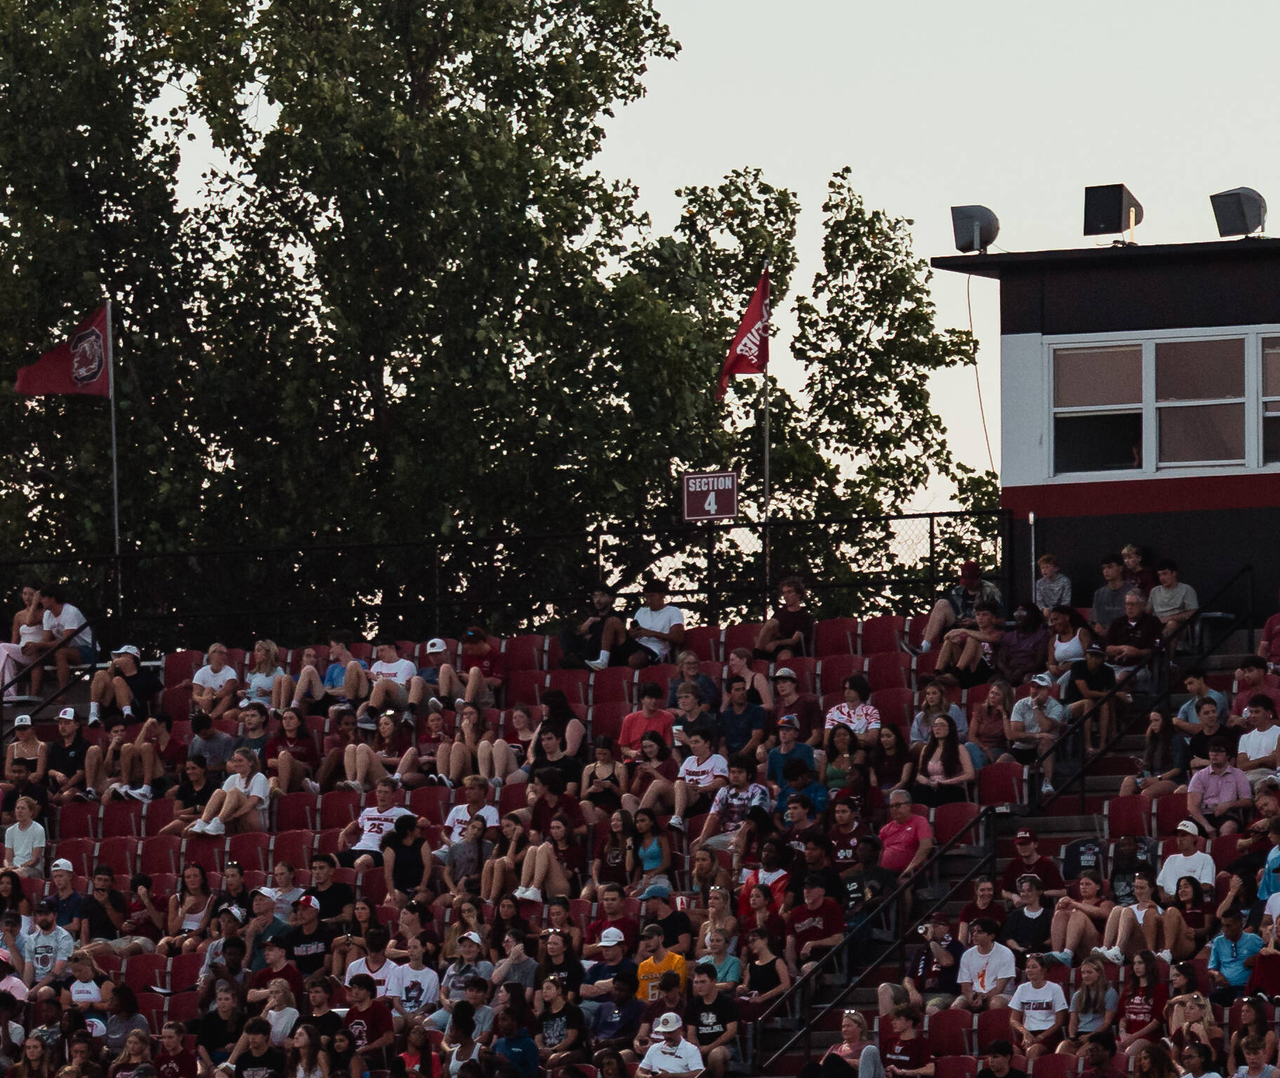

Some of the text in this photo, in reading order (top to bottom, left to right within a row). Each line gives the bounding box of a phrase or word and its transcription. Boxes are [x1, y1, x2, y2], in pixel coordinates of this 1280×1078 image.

[688, 477, 733, 492] SECTION
[703, 491, 718, 515] 4
[369, 822, 385, 835] 25
